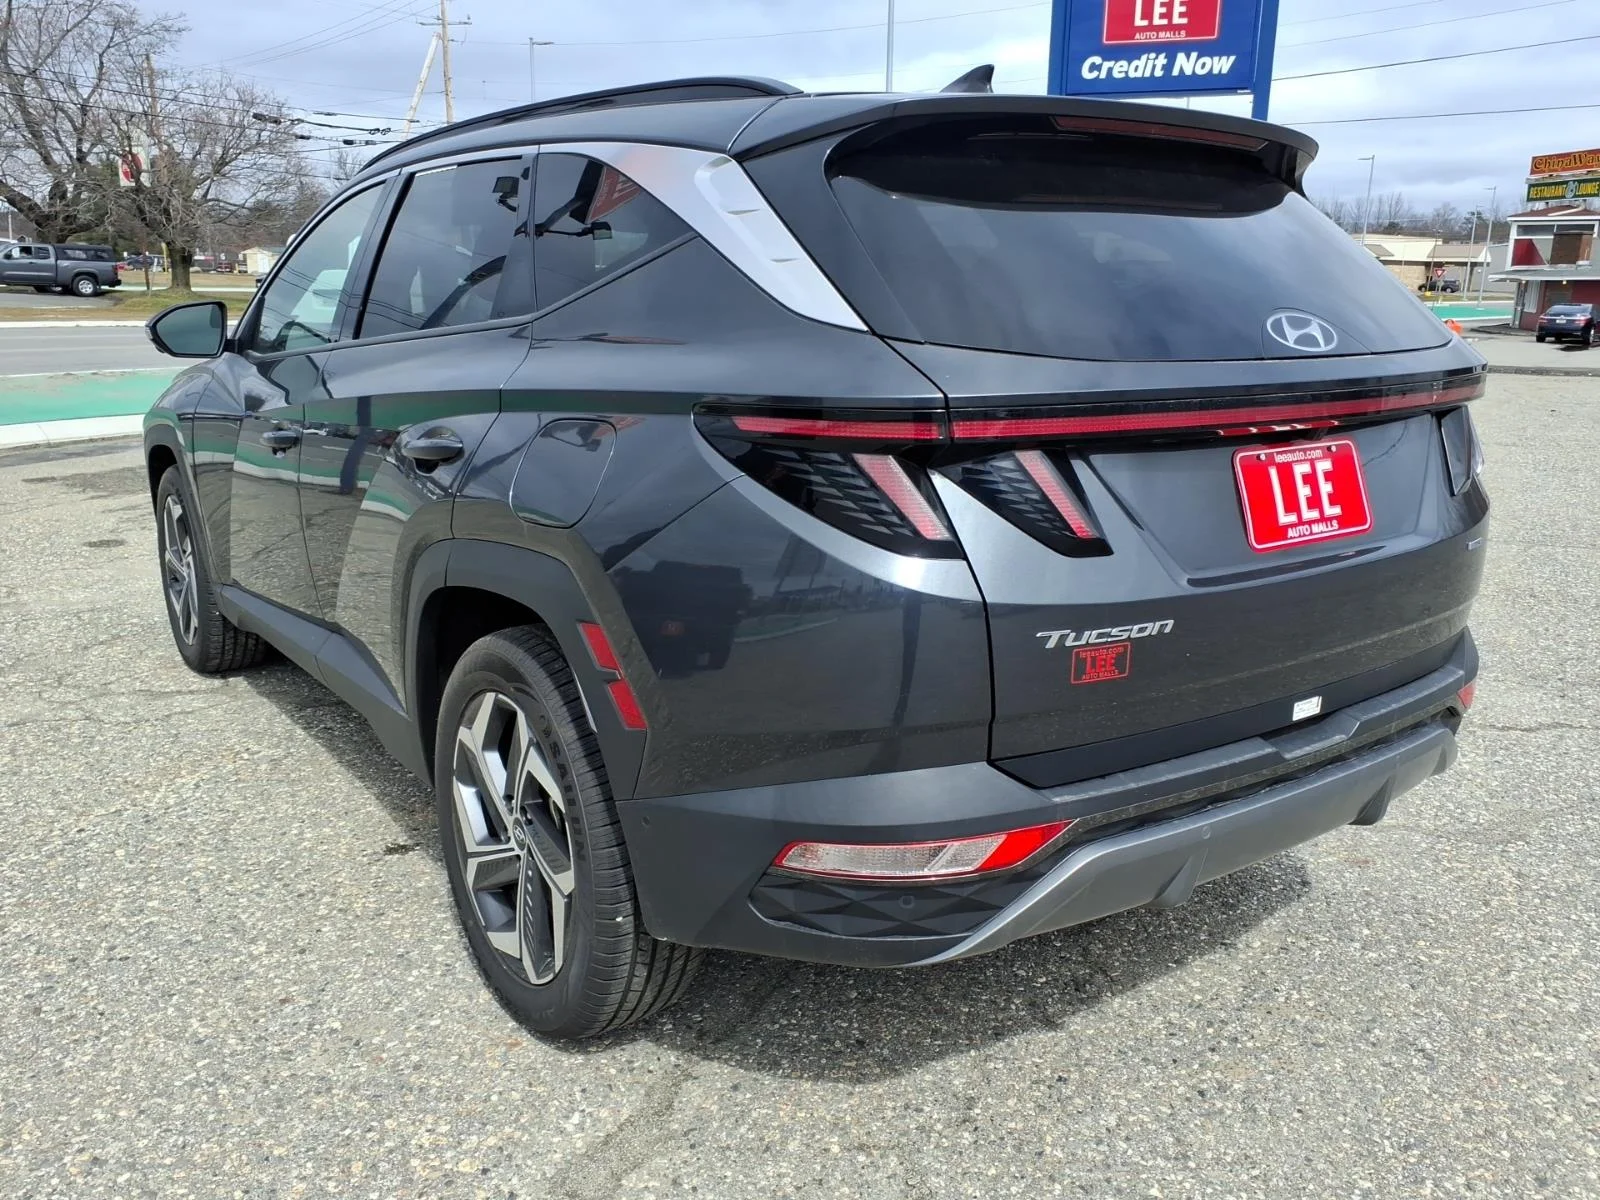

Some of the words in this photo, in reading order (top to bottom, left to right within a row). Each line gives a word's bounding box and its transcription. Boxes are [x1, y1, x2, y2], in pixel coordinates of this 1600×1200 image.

[1134, 0, 1189, 27] LEE
[1134, 31, 1157, 40] AUTO
[1158, 30, 1186, 39] MALLS
[1081, 52, 1168, 80] Credit
[1172, 52, 1236, 77] Now
[1529, 184, 1567, 199] RESTAURANT
[1575, 182, 1599, 195] LOUNGE
[1274, 449, 1323, 463] leeauto.com
[1268, 459, 1342, 526] LEE
[1287, 526, 1311, 538] AUTO
[1312, 520, 1339, 535] MALLS
[1085, 654, 1117, 673] LEE
[1081, 672, 1098, 680] AUTO
